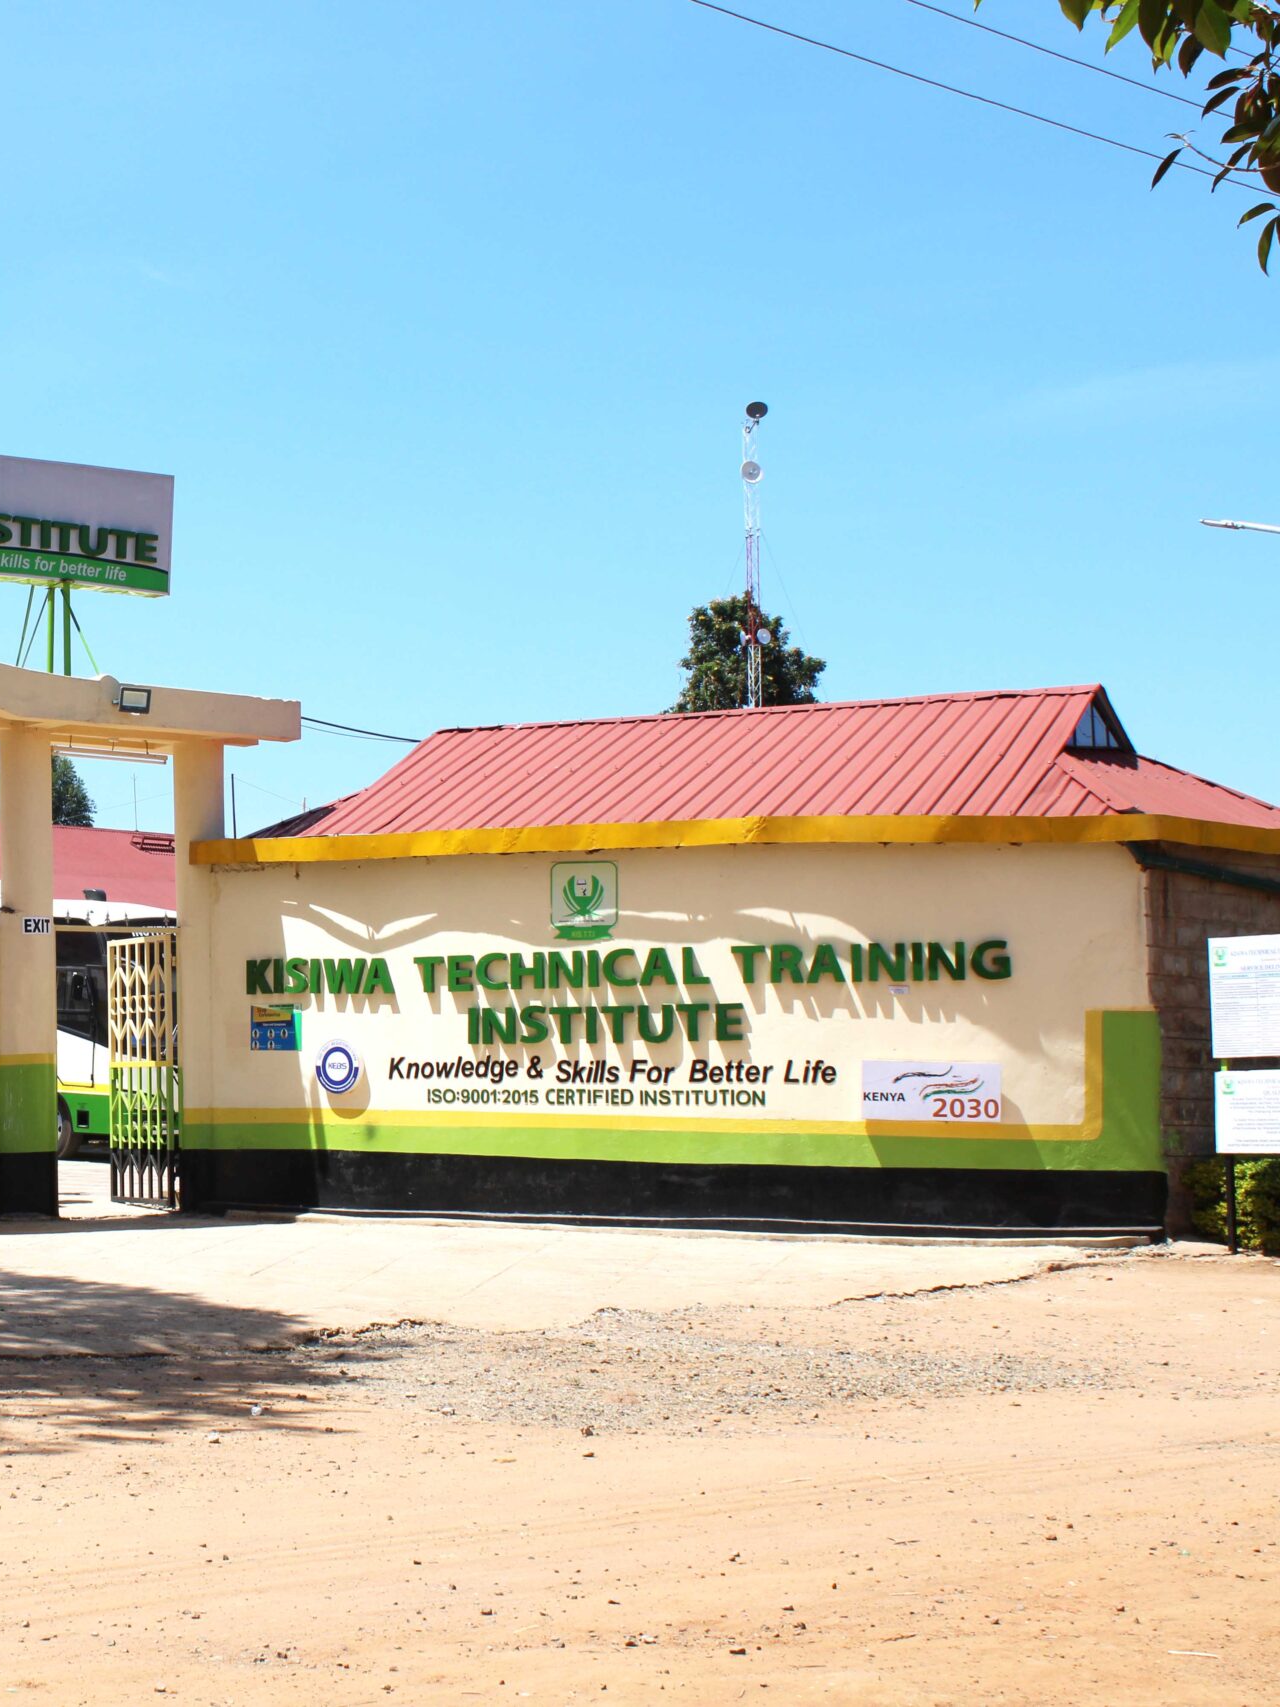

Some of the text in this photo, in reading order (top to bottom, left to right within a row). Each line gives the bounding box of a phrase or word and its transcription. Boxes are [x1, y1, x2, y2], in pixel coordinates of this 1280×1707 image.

[34, 556, 55, 573] for
[59, 559, 100, 578] better
[105, 564, 127, 581] life
[24, 918, 50, 933] EXIT
[246, 940, 1012, 995] KISIWA TECHNICAL TRAINING
[467, 1002, 744, 1046] INSTITUTE
[388, 1055, 837, 1084] Knowledge & Skills For Better Life
[427, 1088, 766, 1106] ISO:9001:2015 CERTIFIED INSTITUTION
[863, 1092, 905, 1102] KENYA
[932, 1097, 999, 1119] 2030
